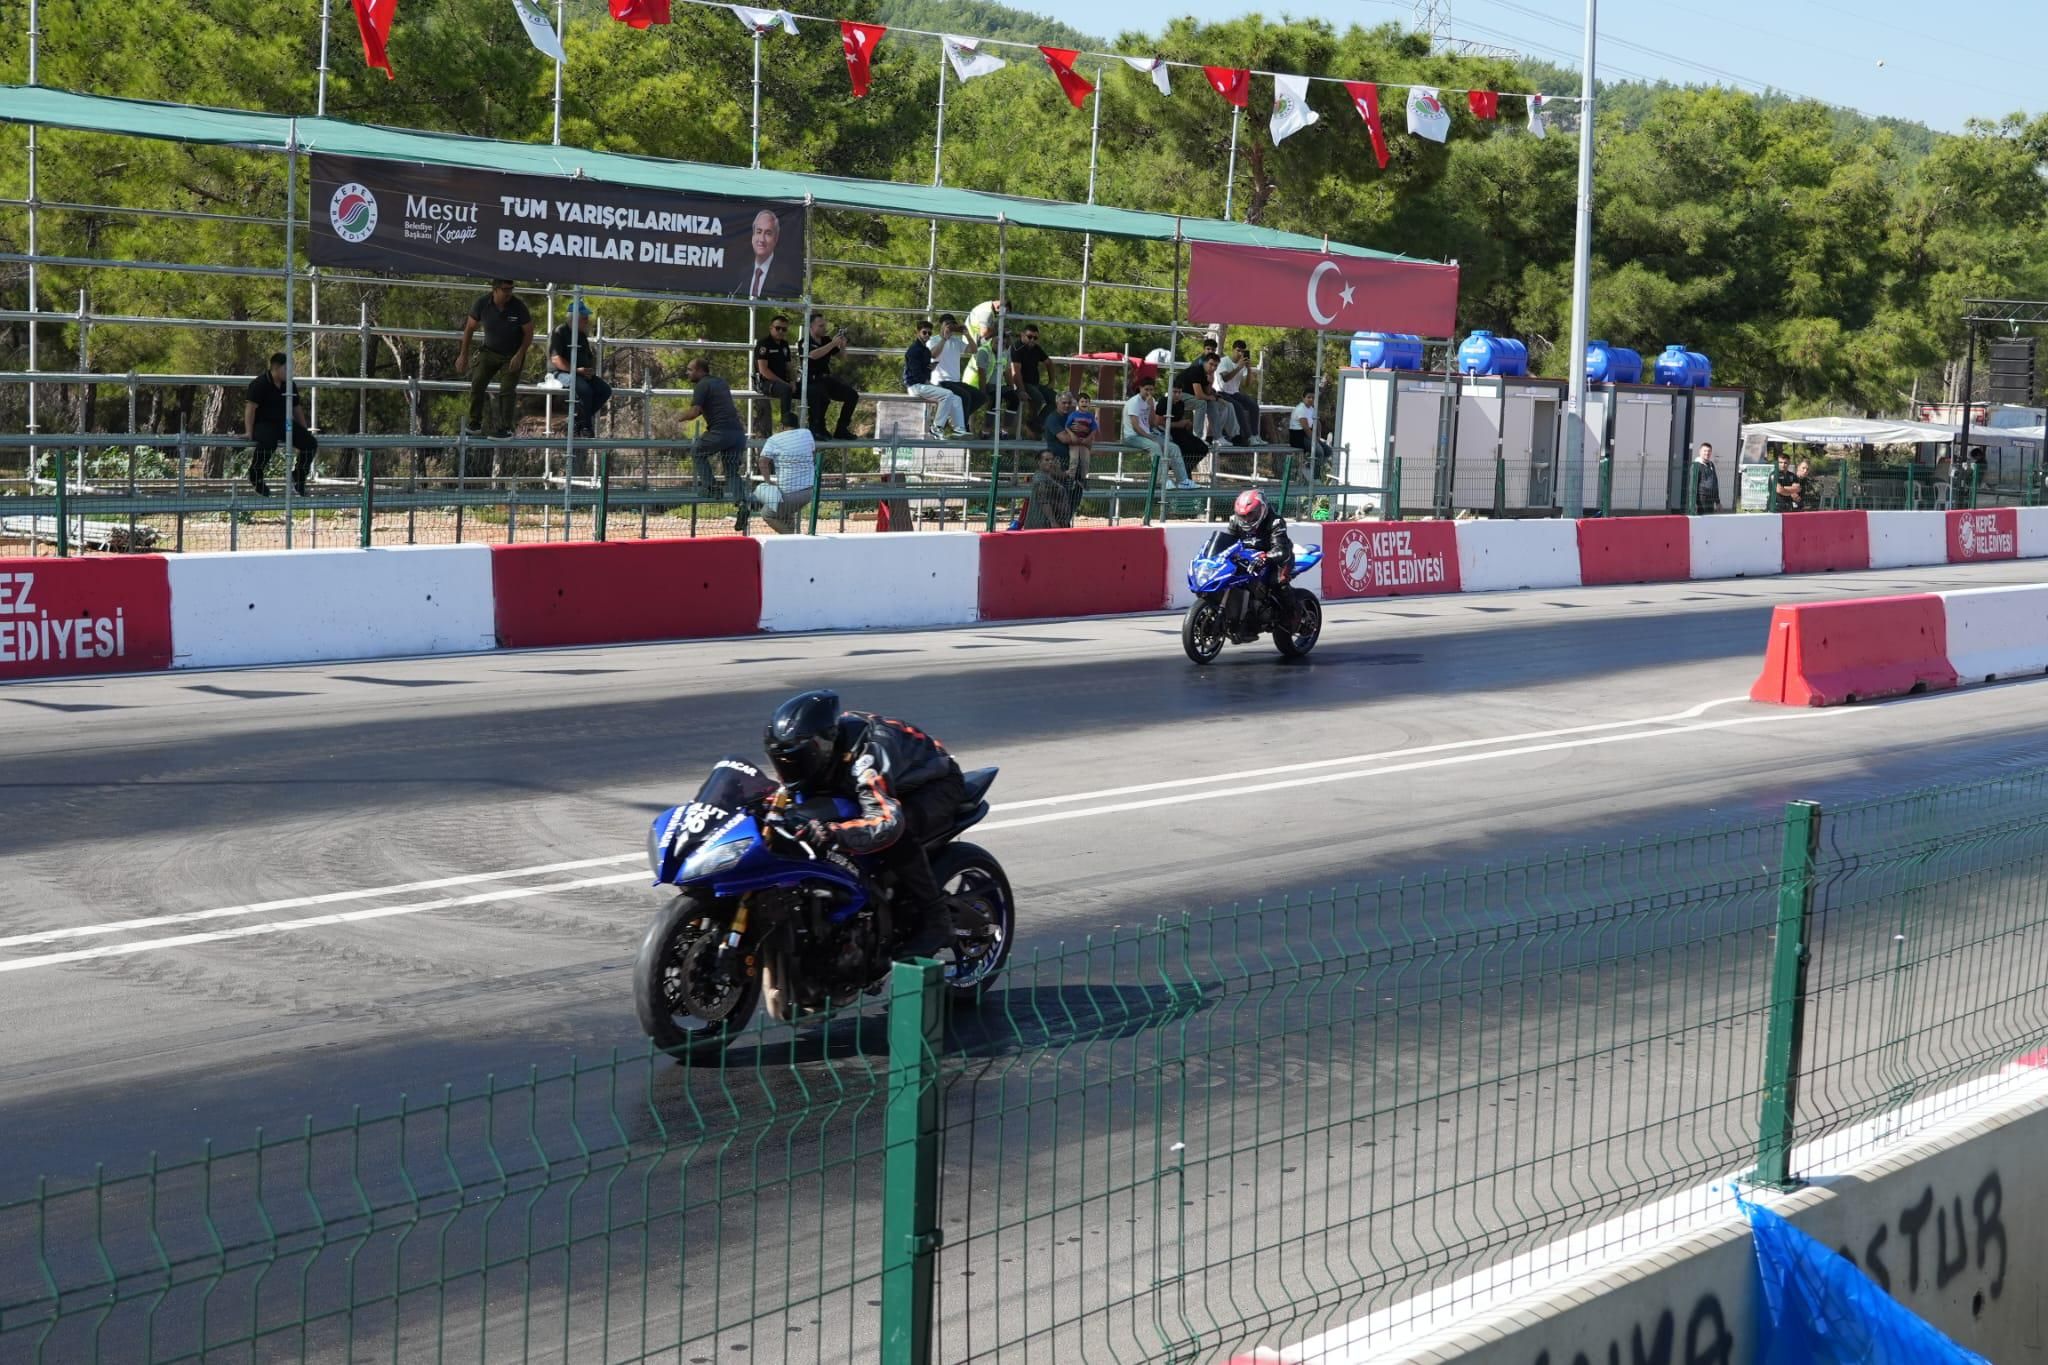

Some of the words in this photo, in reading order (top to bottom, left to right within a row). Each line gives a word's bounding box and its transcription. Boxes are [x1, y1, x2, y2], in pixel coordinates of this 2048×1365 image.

[334, 185, 374, 206] KEPEZ
[405, 194, 479, 223] Mesut
[404, 221, 433, 233] Belediye
[555, 201, 723, 236] YARIŞÇILARIMIZA
[435, 222, 478, 244] Kocagöz
[498, 229, 634, 261] BAŞARILAR
[639, 241, 725, 268] DİLERİM
[1975, 513, 1997, 533] KEPEZ
[1372, 530, 1413, 557] KEPEZ
[1374, 552, 1444, 586] BELEDİYESİ
[1838, 1164, 2008, 1300] STUR
